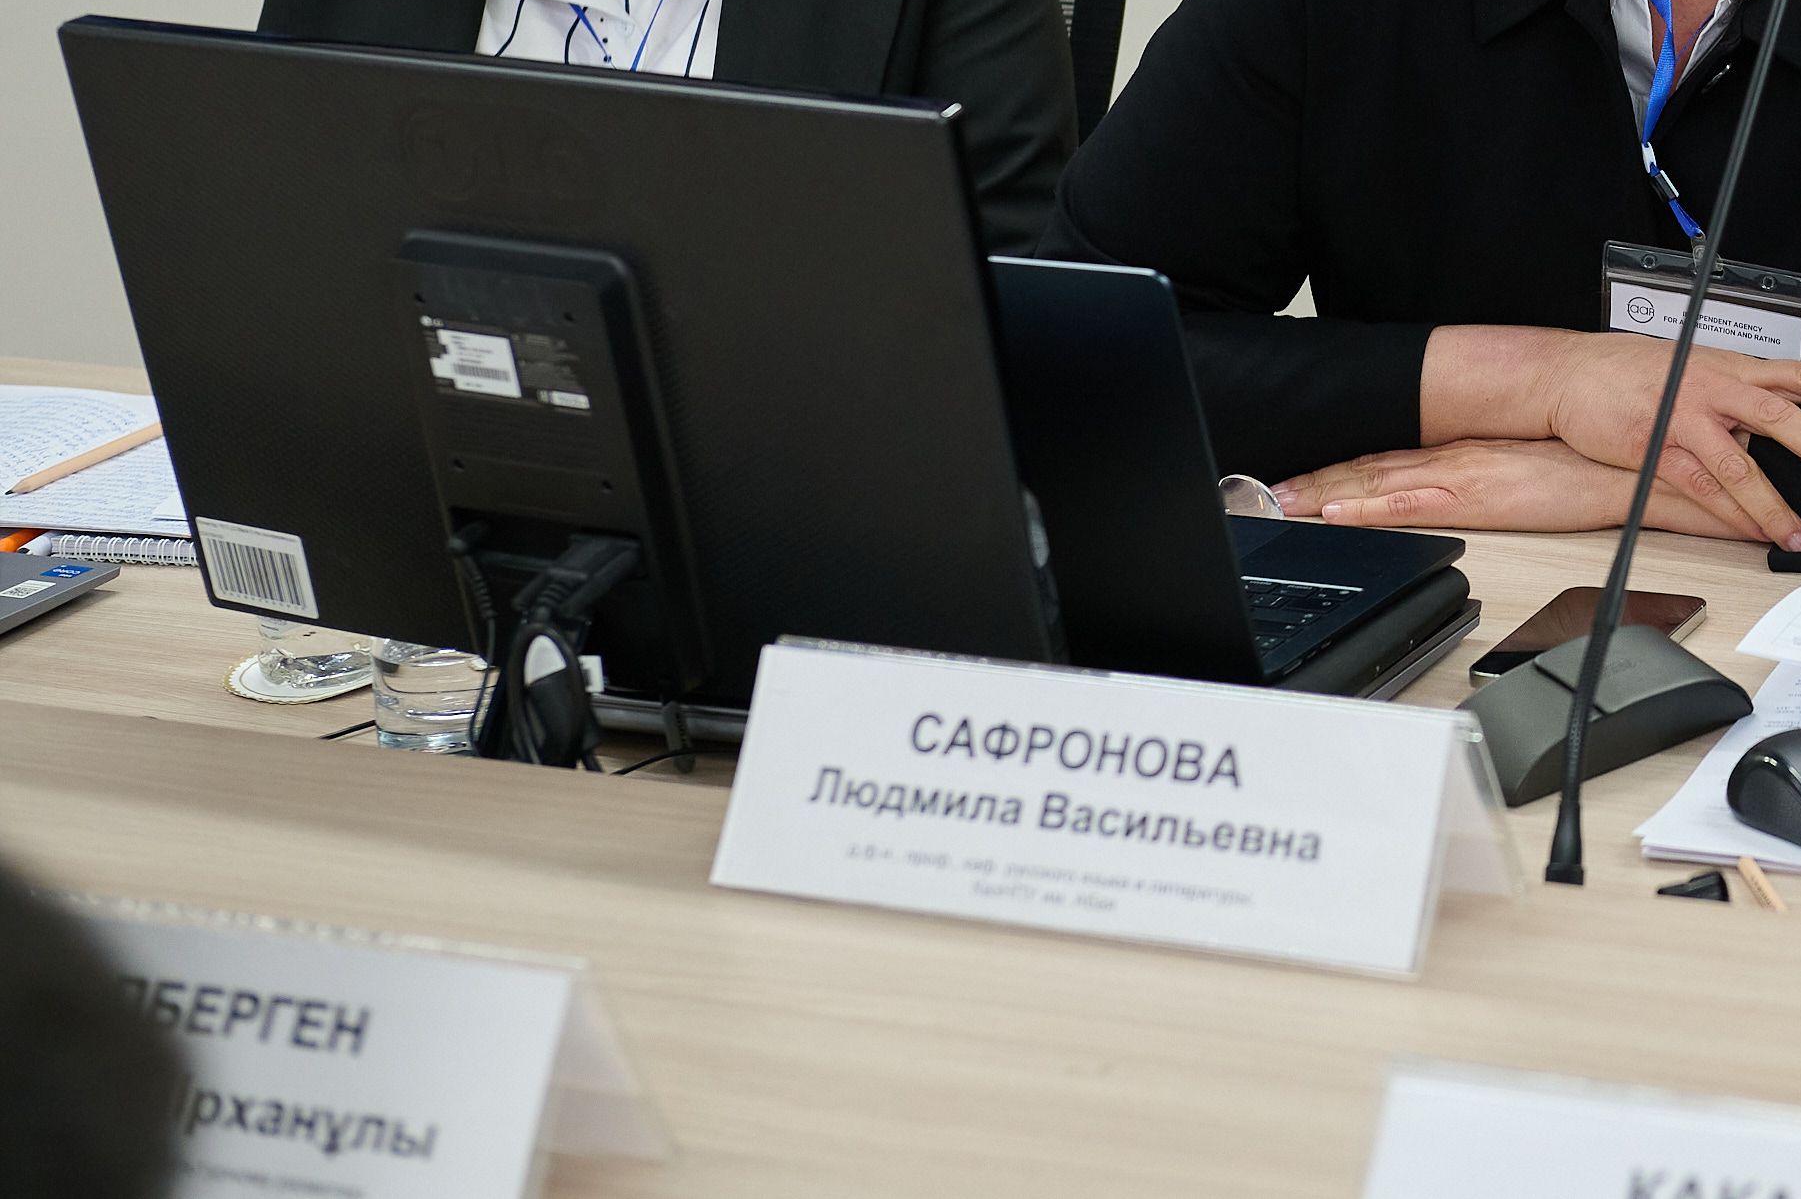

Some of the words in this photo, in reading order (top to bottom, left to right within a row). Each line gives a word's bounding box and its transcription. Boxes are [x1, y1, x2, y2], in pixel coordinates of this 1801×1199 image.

[1663, 315, 1678, 324] FOR
[1679, 319, 1736, 336] AREDITATION
[1737, 331, 1753, 340] AND
[1754, 334, 1781, 345] RATING
[1683, 310, 1731, 327] IPENDENT
[1733, 321, 1763, 333] AGENCY
[909, 710, 1244, 789] САФРОНОВА
[808, 766, 1022, 827] Людмила
[1038, 792, 1323, 863] Васильевна
[180, 1082, 438, 1160] рханұлы
